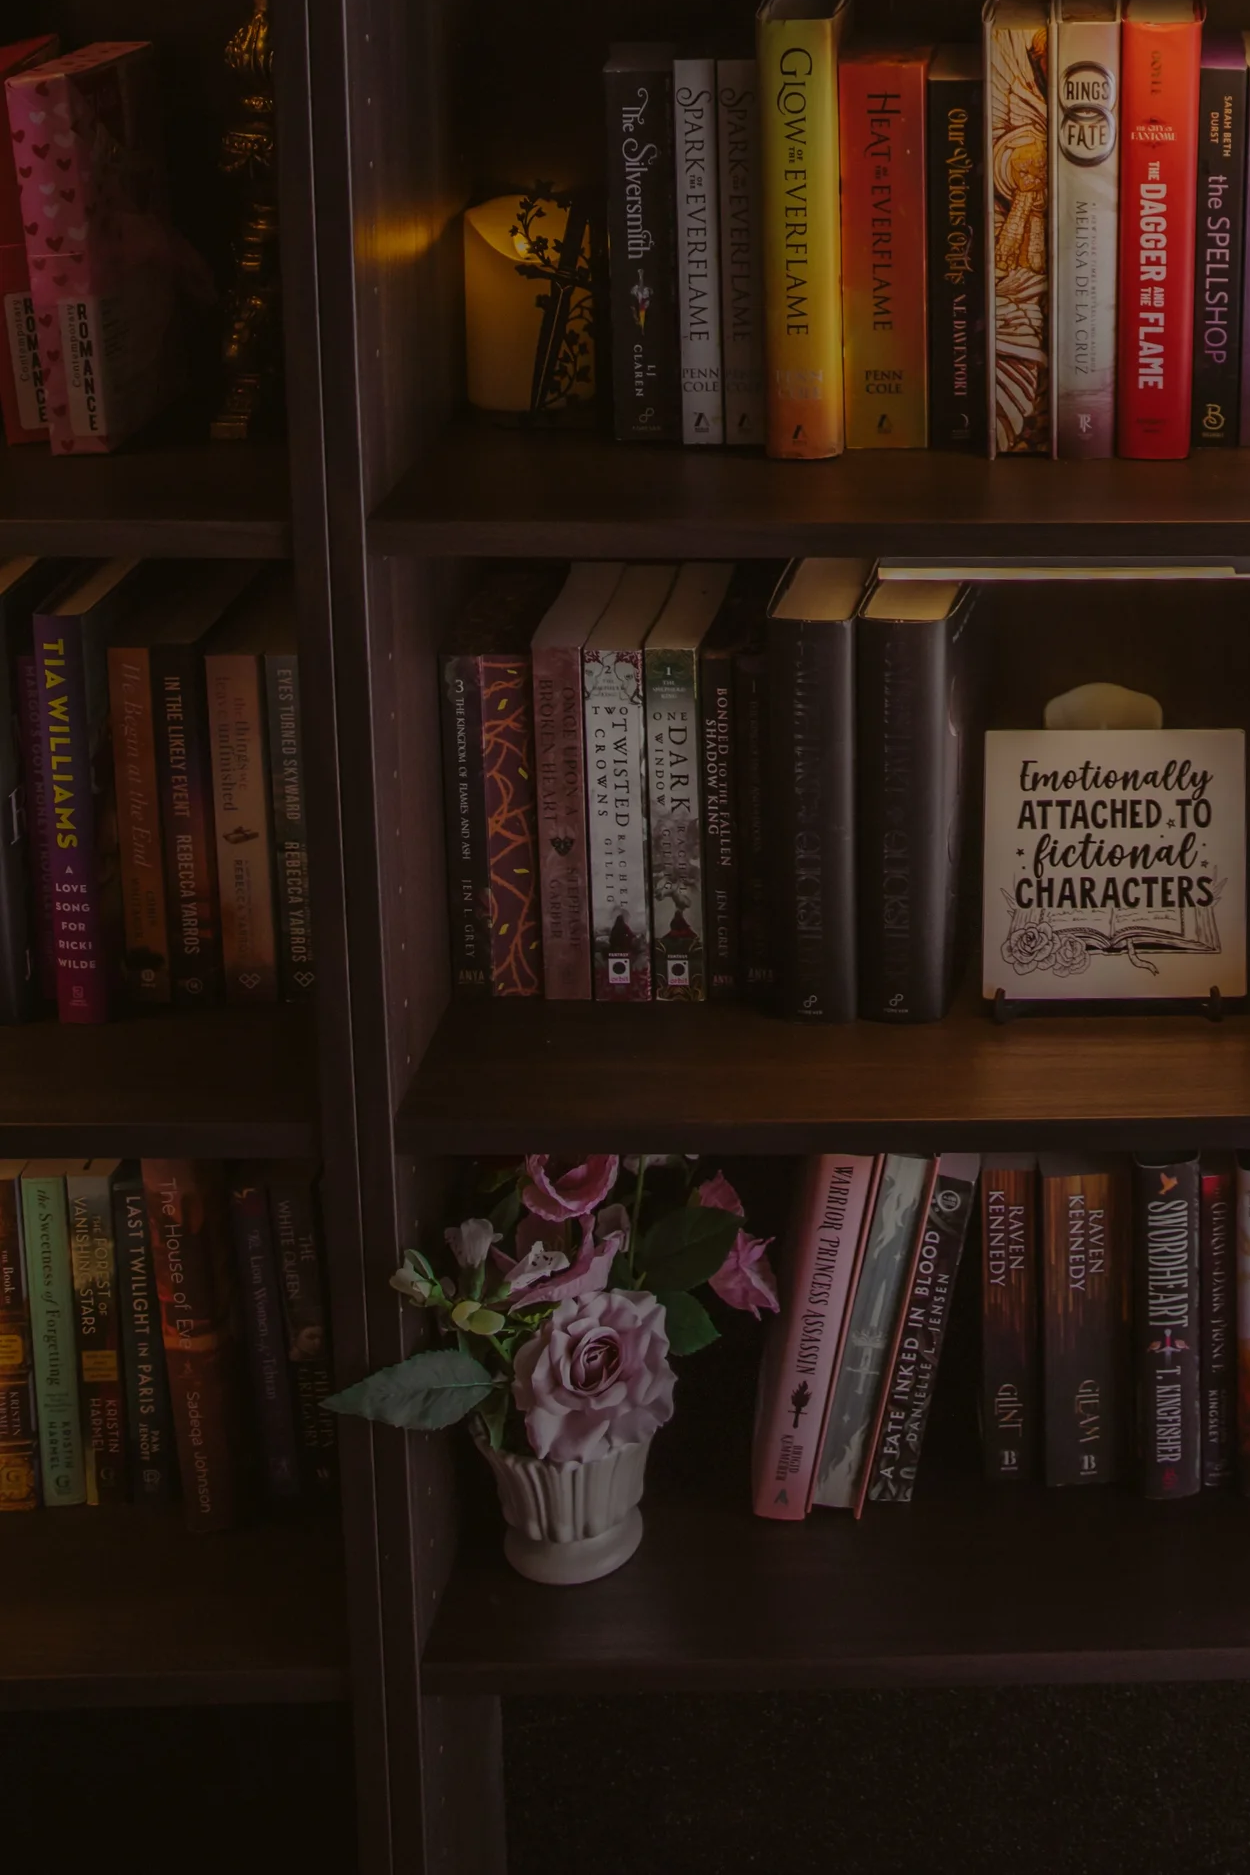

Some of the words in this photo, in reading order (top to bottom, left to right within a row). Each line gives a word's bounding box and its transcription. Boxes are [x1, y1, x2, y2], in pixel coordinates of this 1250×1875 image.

[621, 88, 648, 132] The
[776, 47, 813, 146] GLOW
[1065, 81, 1110, 101] RINGS
[1067, 126, 1107, 149] FATE
[1147, 161, 1160, 181] THE
[1208, 175, 1228, 210] the
[621, 138, 661, 260] Silversmith
[784, 168, 809, 335] EVERFLAME
[1140, 184, 1168, 283] DAGGER
[1140, 287, 1151, 307] THE
[1153, 286, 1165, 307] AND
[1206, 216, 1230, 363] SPELLSHOP
[76, 303, 97, 431] ROMANCE
[1138, 313, 1164, 390] FLAME
[41, 638, 65, 690] TIA
[591, 705, 628, 716] TWO
[653, 712, 689, 721] ONE
[46, 695, 78, 850] WILLIAMS
[595, 728, 608, 818] CROWNS
[612, 720, 629, 827] TWISTED
[654, 734, 666, 806] WINDOW
[669, 725, 691, 813] DARK
[1020, 759, 1213, 800] Emotionally
[1017, 799, 1162, 829] ATTACHED
[1176, 799, 1212, 828] TO
[65, 865, 74, 875] A
[1034, 831, 1198, 878] fictional
[55, 883, 87, 894] LOVE
[56, 902, 91, 913] SONG
[1016, 876, 1214, 909] CHARACTERS
[57, 939, 93, 951] RICKI
[61, 921, 86, 932] FOR
[57, 958, 97, 969] WILDE
[125, 1195, 143, 1238] LAST
[825, 1166, 854, 1231] WARRIOR
[808, 1236, 841, 1307] PRINCESS
[914, 1230, 941, 1296] BLOOD
[1147, 1199, 1189, 1328] SWORDHEART
[128, 1246, 149, 1335] TWILIGHT
[909, 1306, 924, 1322] IN
[137, 1342, 149, 1357] IN
[796, 1309, 826, 1376] ASSASSIN
[136, 1364, 154, 1414] PARIS
[895, 1338, 918, 1401] INKED
[1156, 1366, 1183, 1380] T.
[883, 1409, 905, 1455] FATE
[1155, 1383, 1183, 1464] KINGFISHER
[880, 1466, 894, 1479] A
